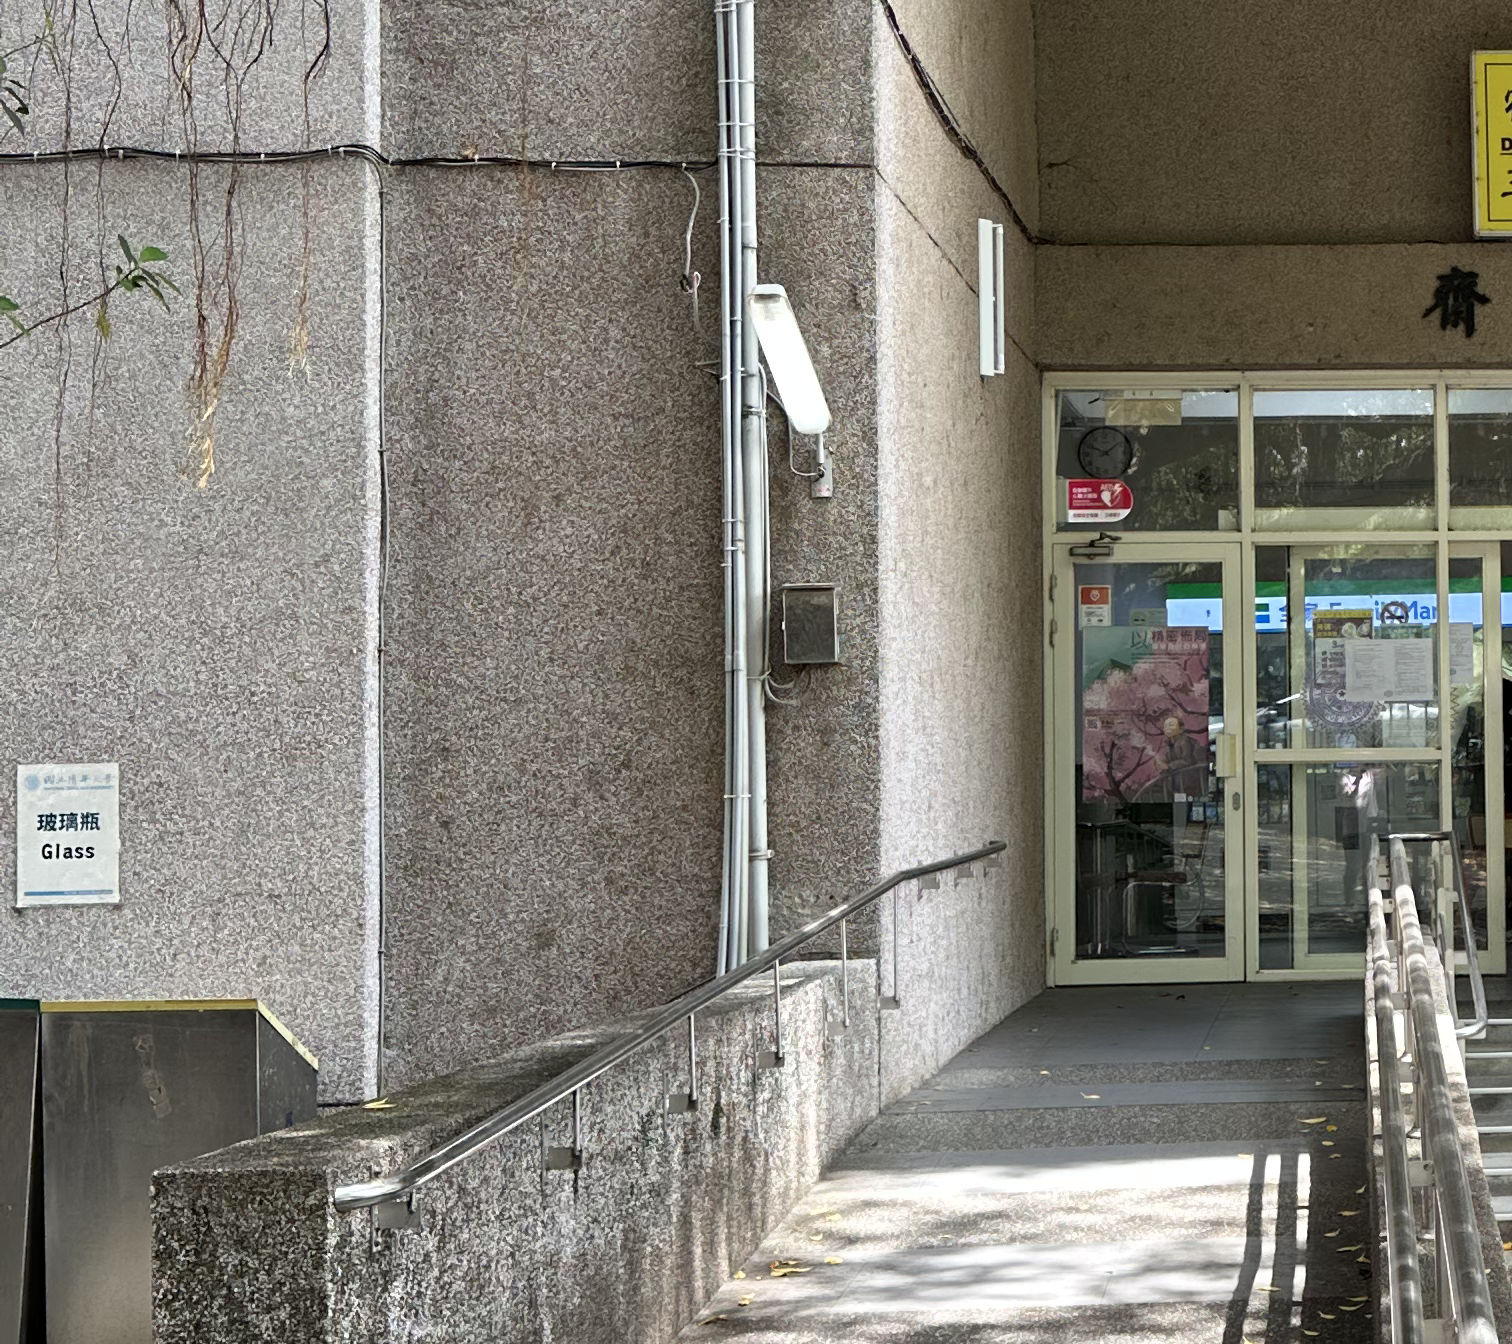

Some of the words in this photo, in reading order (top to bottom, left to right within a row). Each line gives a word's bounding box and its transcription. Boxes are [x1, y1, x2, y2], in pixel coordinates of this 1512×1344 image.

[36, 812, 101, 832] 玻璃瓶
[41, 843, 95, 860] Glass
